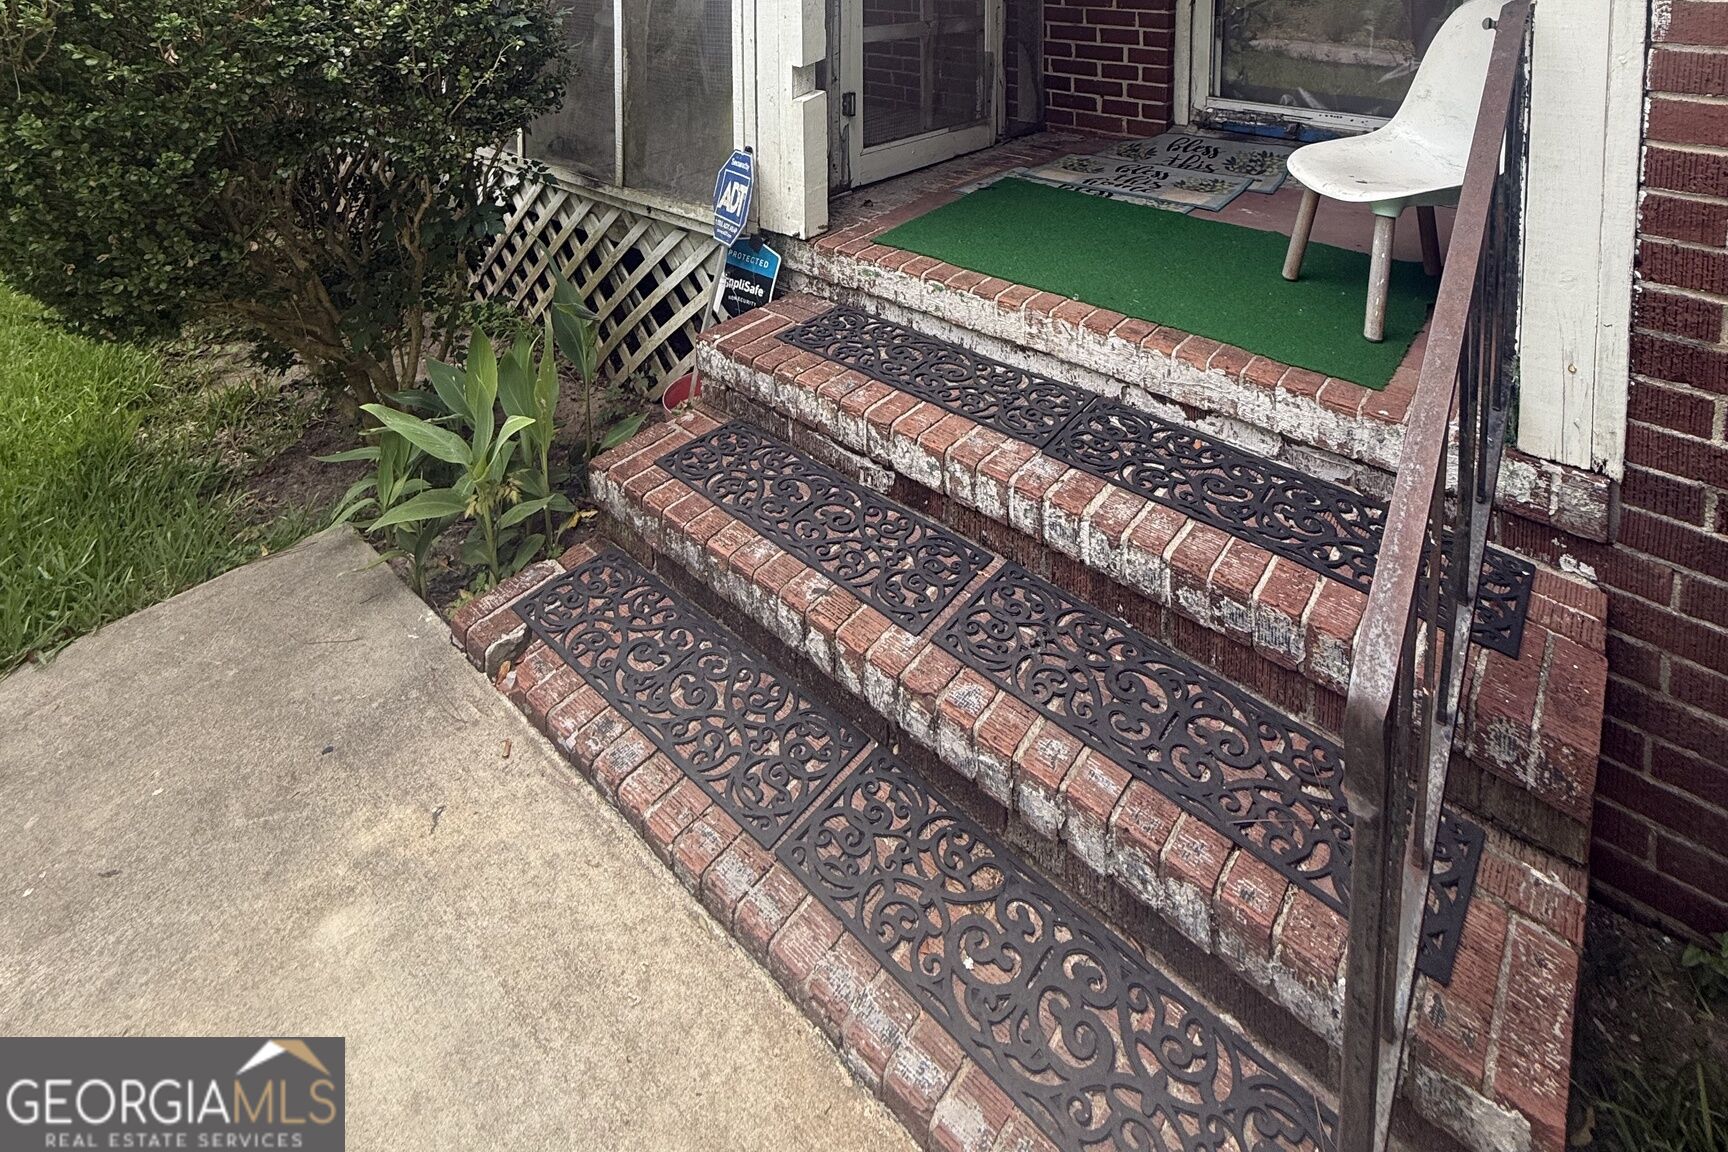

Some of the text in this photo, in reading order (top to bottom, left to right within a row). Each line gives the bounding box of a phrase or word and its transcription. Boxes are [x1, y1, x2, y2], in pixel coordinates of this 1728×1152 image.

[717, 180, 749, 217] ADT
[728, 249, 769, 268] PROTECTED
[725, 277, 764, 297] mpliSafe
